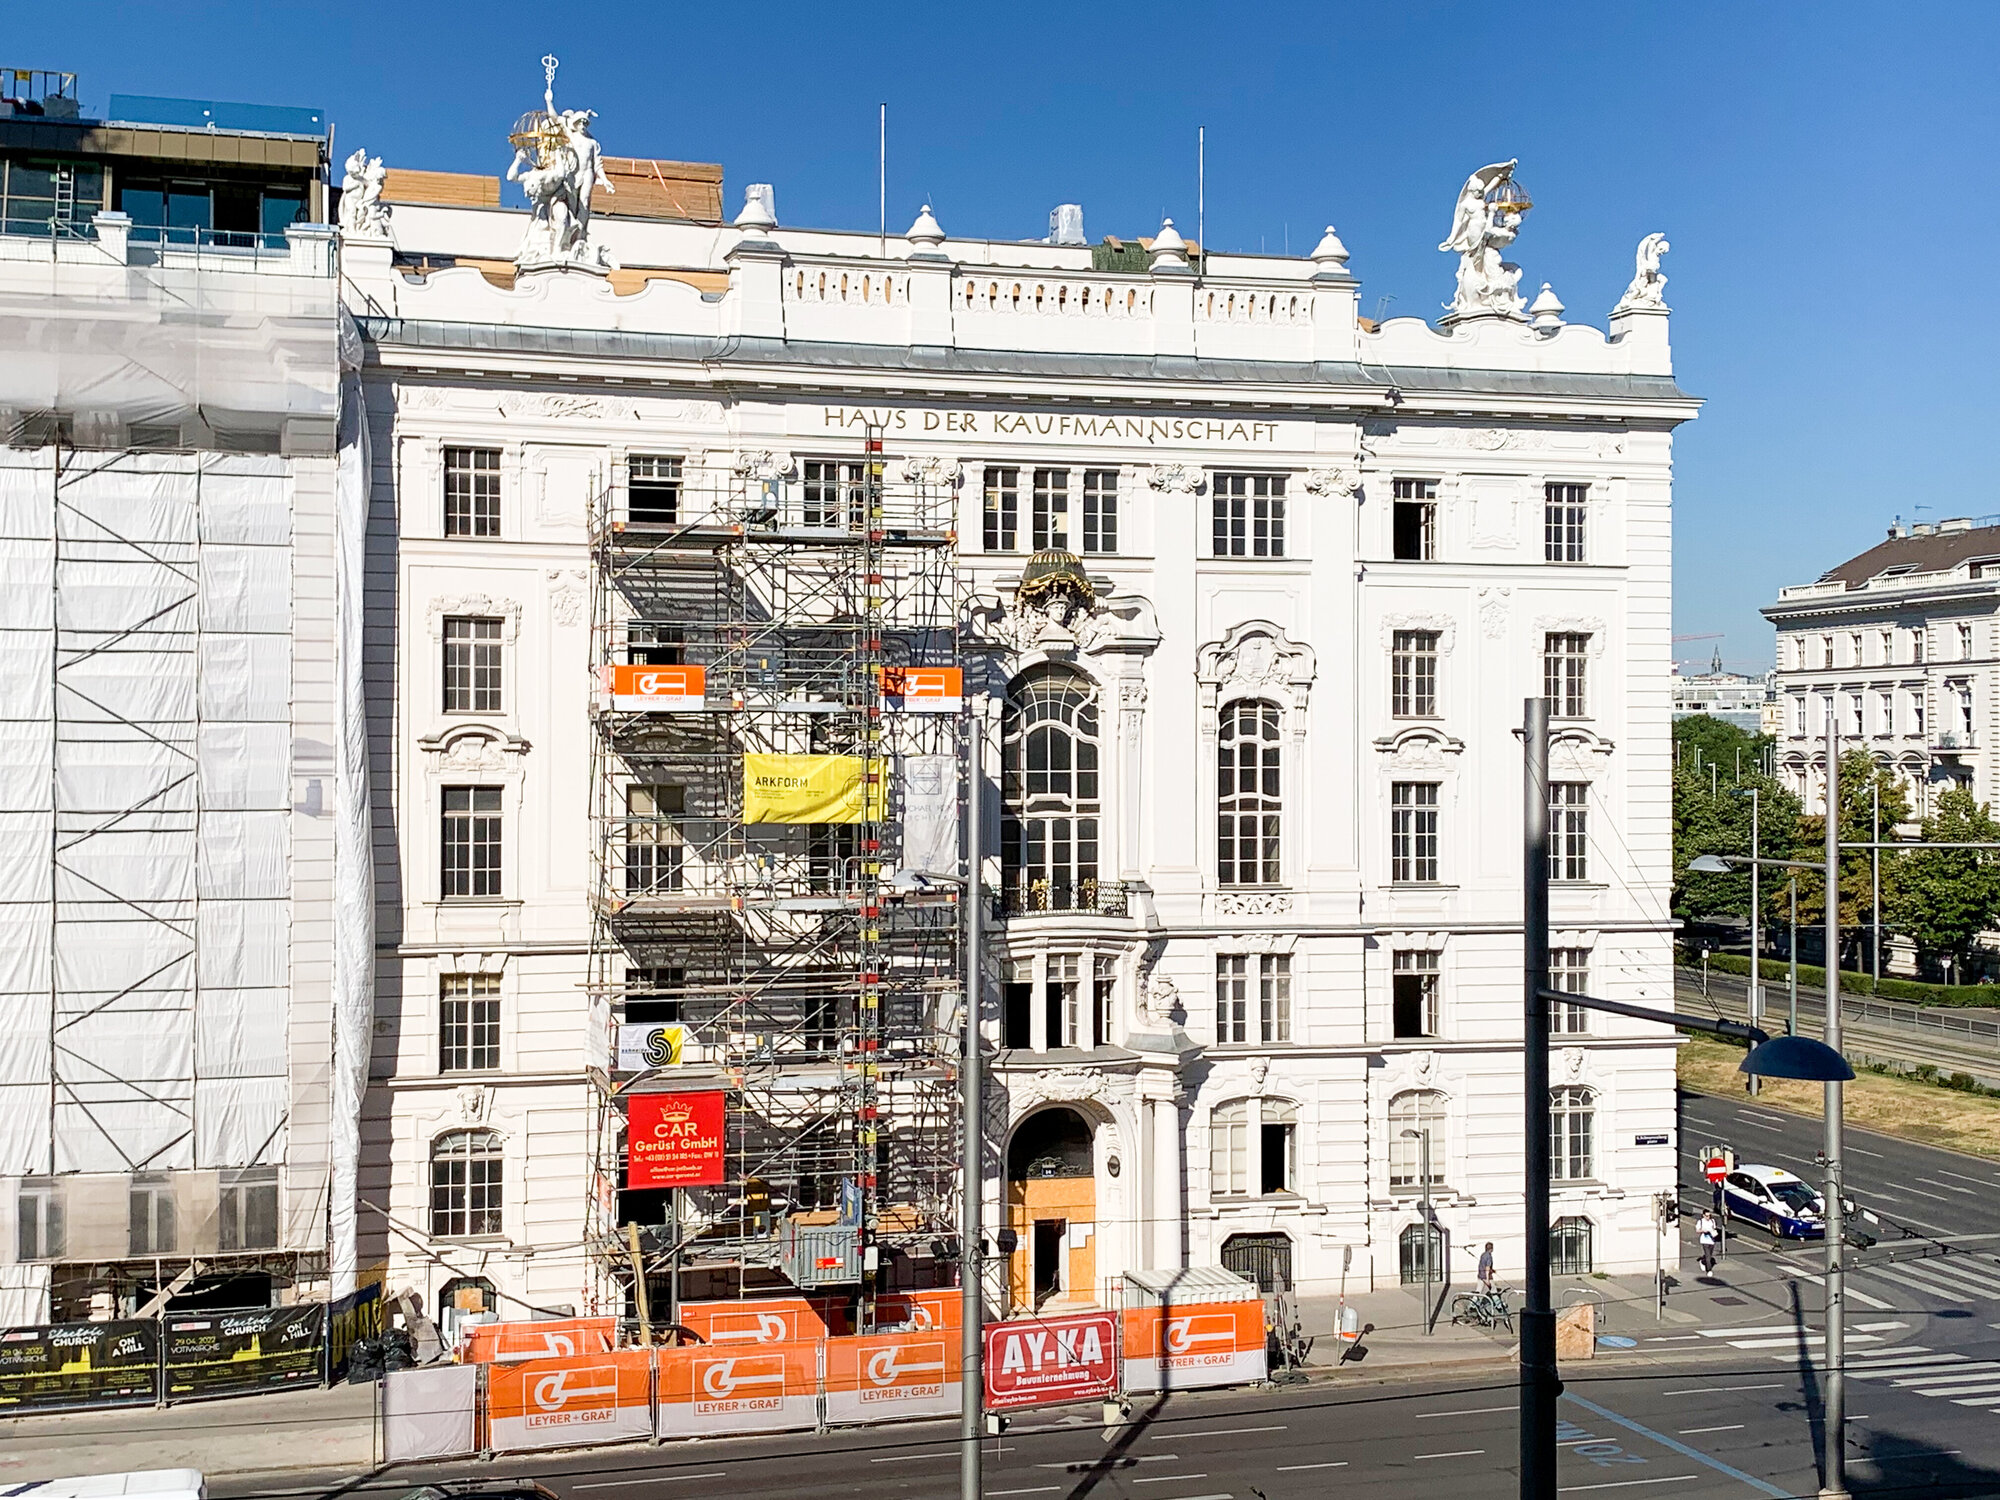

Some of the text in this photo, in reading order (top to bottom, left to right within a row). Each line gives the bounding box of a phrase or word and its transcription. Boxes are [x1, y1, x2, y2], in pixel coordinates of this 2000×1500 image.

[825, 407, 1279, 442] HAUS DER KAUFMANNSCHAFT
[755, 776, 808, 788] ARKFORM
[654, 1122, 698, 1138] CAR
[635, 1136, 718, 1152] Gerüst GmbH
[224, 1324, 267, 1336] CHURCH
[281, 1327, 312, 1343] A HILL
[286, 1322, 302, 1334] ON
[52, 1336, 97, 1347] CHURCH
[119, 1336, 135, 1347] ON
[112, 1342, 145, 1357] A HILL
[1001, 1326, 1104, 1375] AY-KA
[1158, 1357, 1195, 1369] LEYRER
[1203, 1354, 1232, 1365] GRAF
[1016, 1370, 1090, 1386] Bauunternehmung
[863, 1388, 902, 1400] LEYRER
[911, 1385, 940, 1397] GRAF
[697, 1401, 739, 1413] LEYRER
[749, 1398, 780, 1410] GRAF
[529, 1413, 571, 1426] LEYRER
[581, 1410, 612, 1422] GRAF
